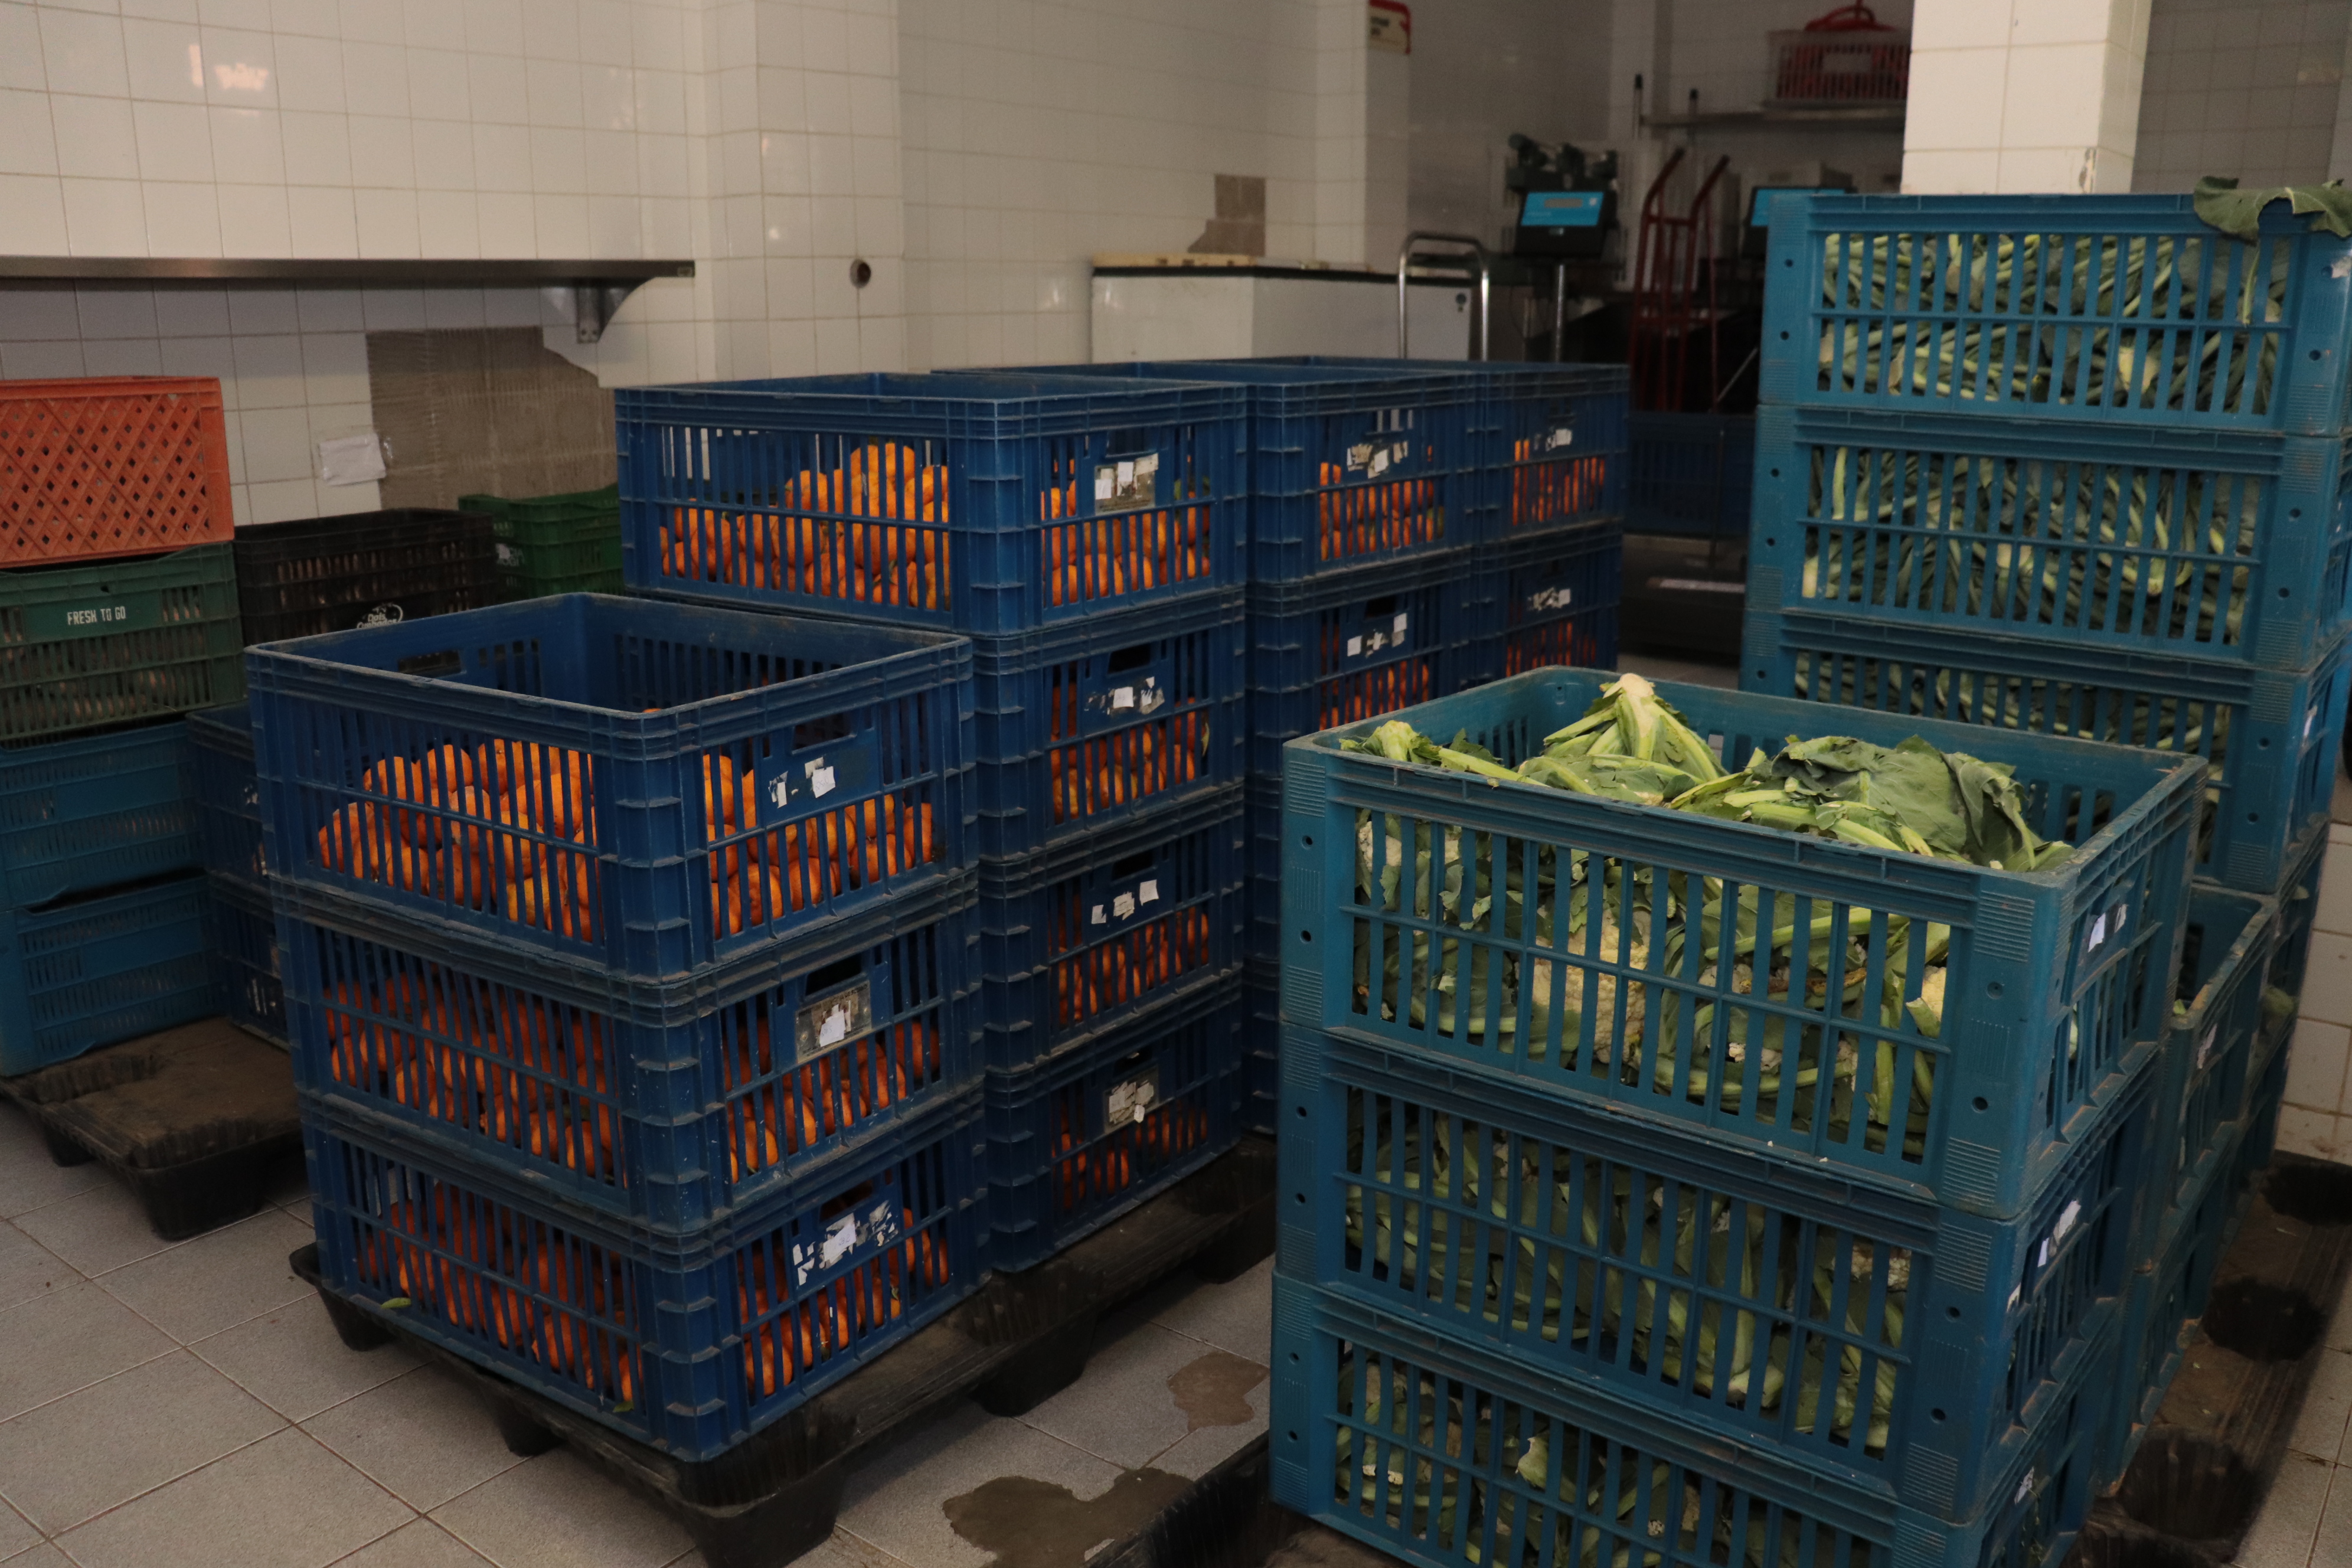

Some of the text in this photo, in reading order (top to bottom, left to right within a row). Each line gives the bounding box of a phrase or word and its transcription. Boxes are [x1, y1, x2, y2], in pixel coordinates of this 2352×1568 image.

[67, 606, 126, 625] FRESH TO GO
